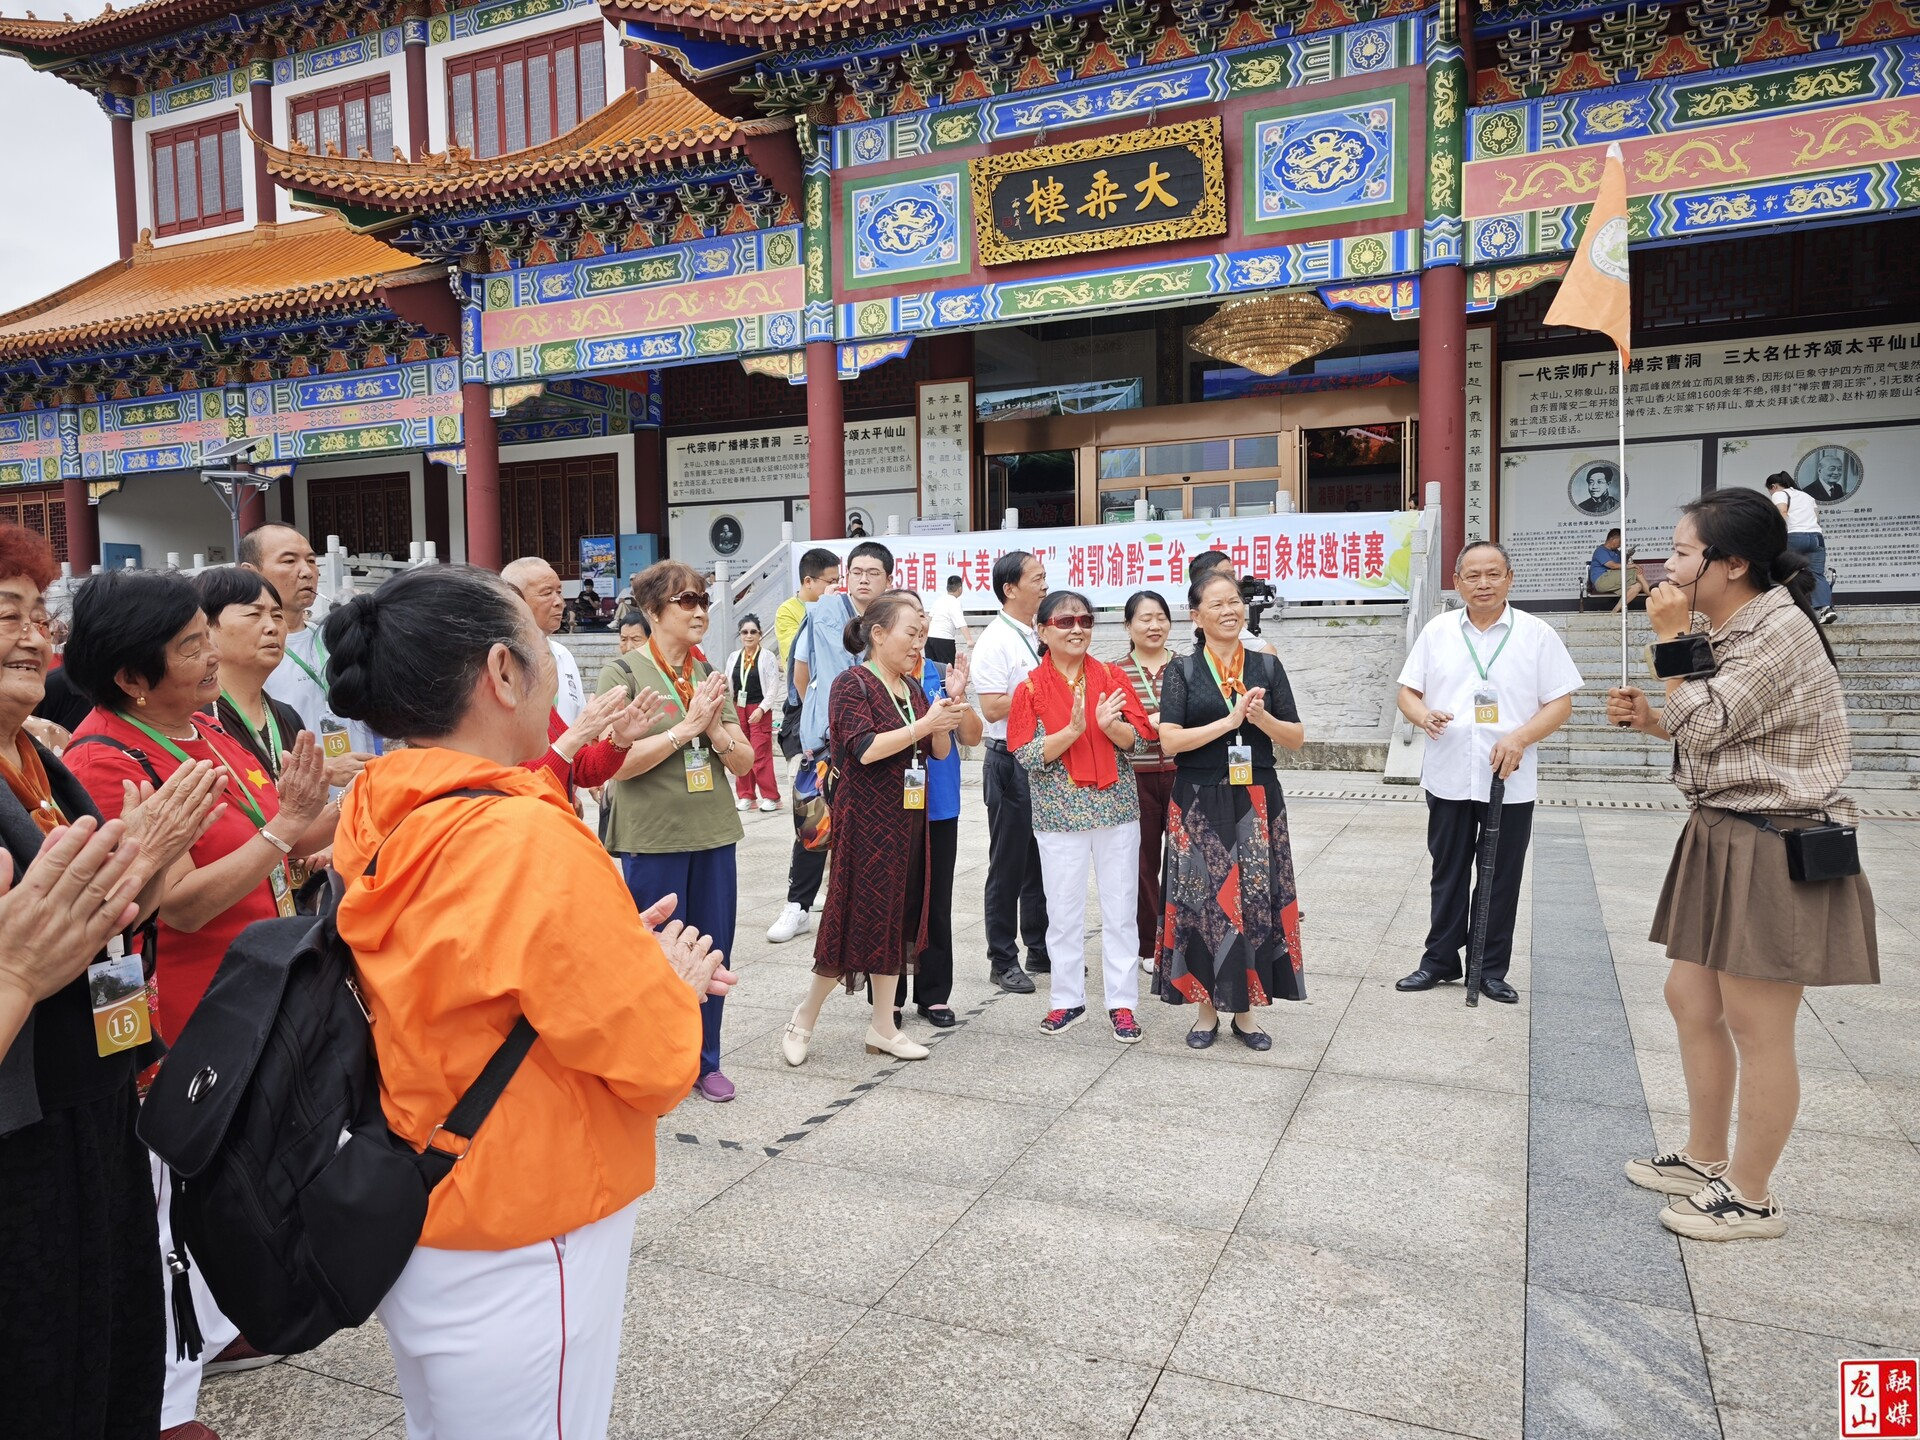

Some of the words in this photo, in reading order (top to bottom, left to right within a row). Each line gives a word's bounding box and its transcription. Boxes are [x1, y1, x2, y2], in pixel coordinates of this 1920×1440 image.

[1482, 710, 1492, 718] 15
[331, 739, 343, 750] 15
[694, 774, 706, 785] 15
[1236, 770, 1247, 779] 15
[909, 793, 919, 803] 15
[291, 869, 303, 880] 15
[111, 1013, 135, 1038] 15
